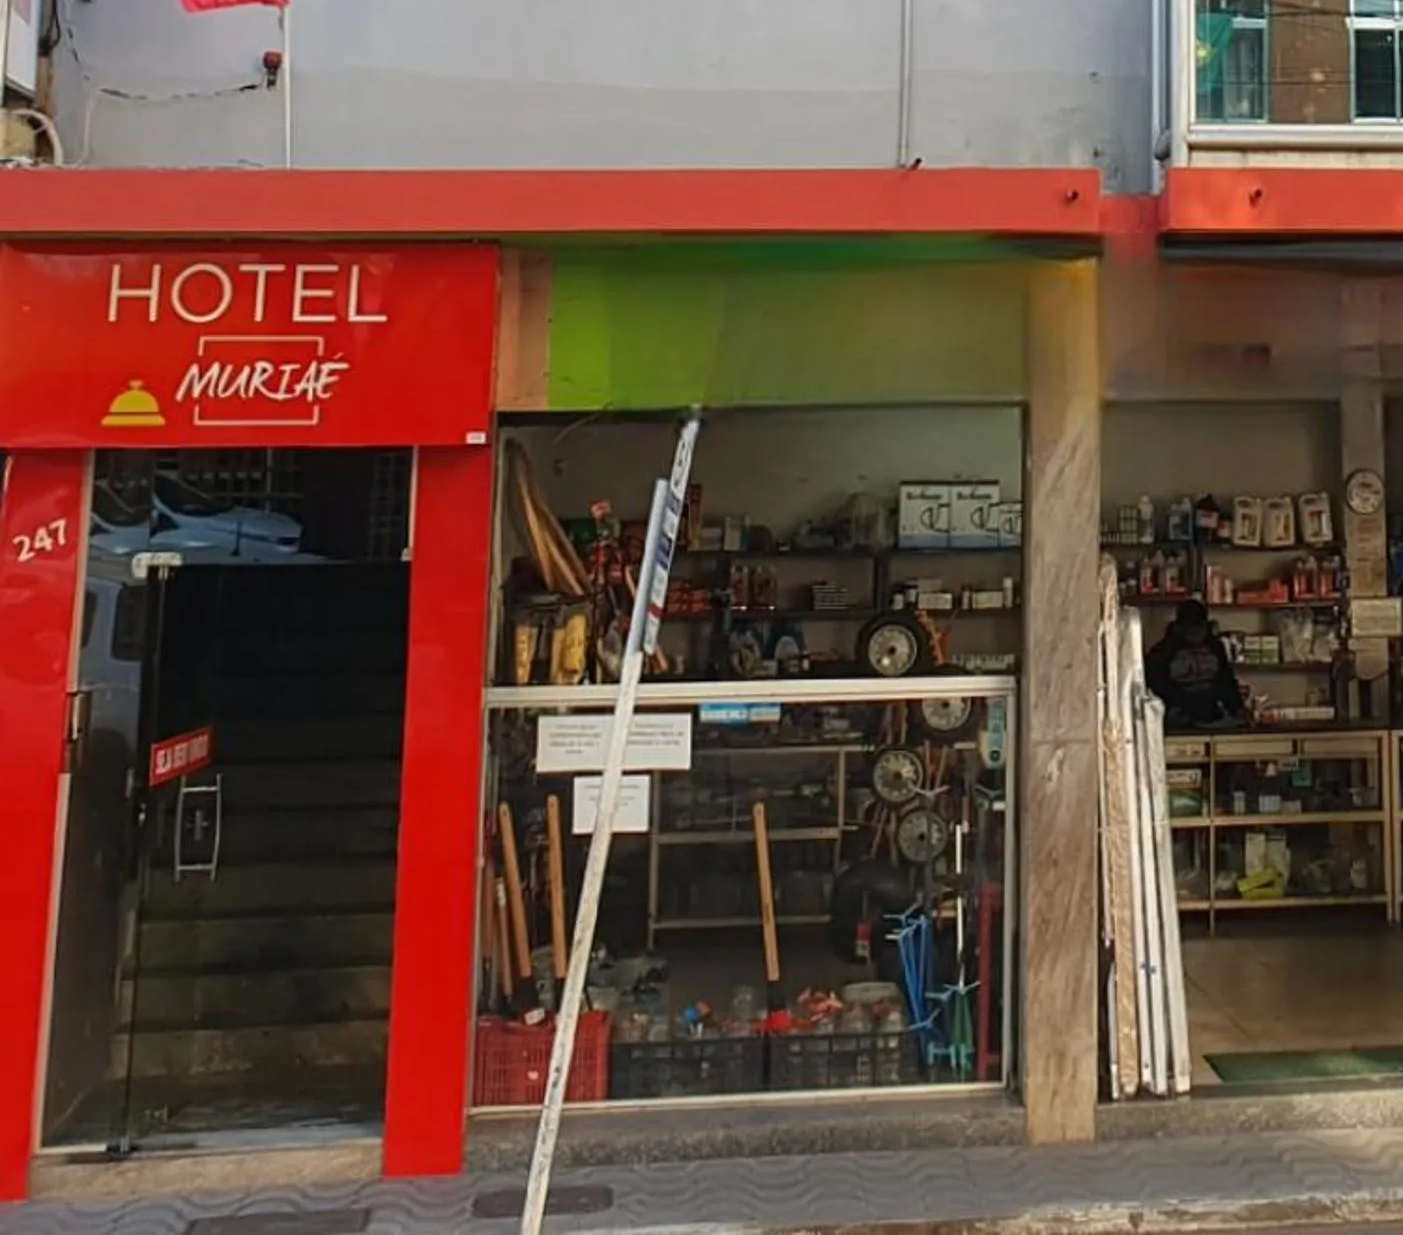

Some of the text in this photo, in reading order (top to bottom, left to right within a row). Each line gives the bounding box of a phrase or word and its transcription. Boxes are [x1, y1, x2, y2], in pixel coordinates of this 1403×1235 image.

[108, 263, 388, 323] HOTEL
[176, 353, 349, 401] MURIAÉ
[13, 519, 67, 562] 247
